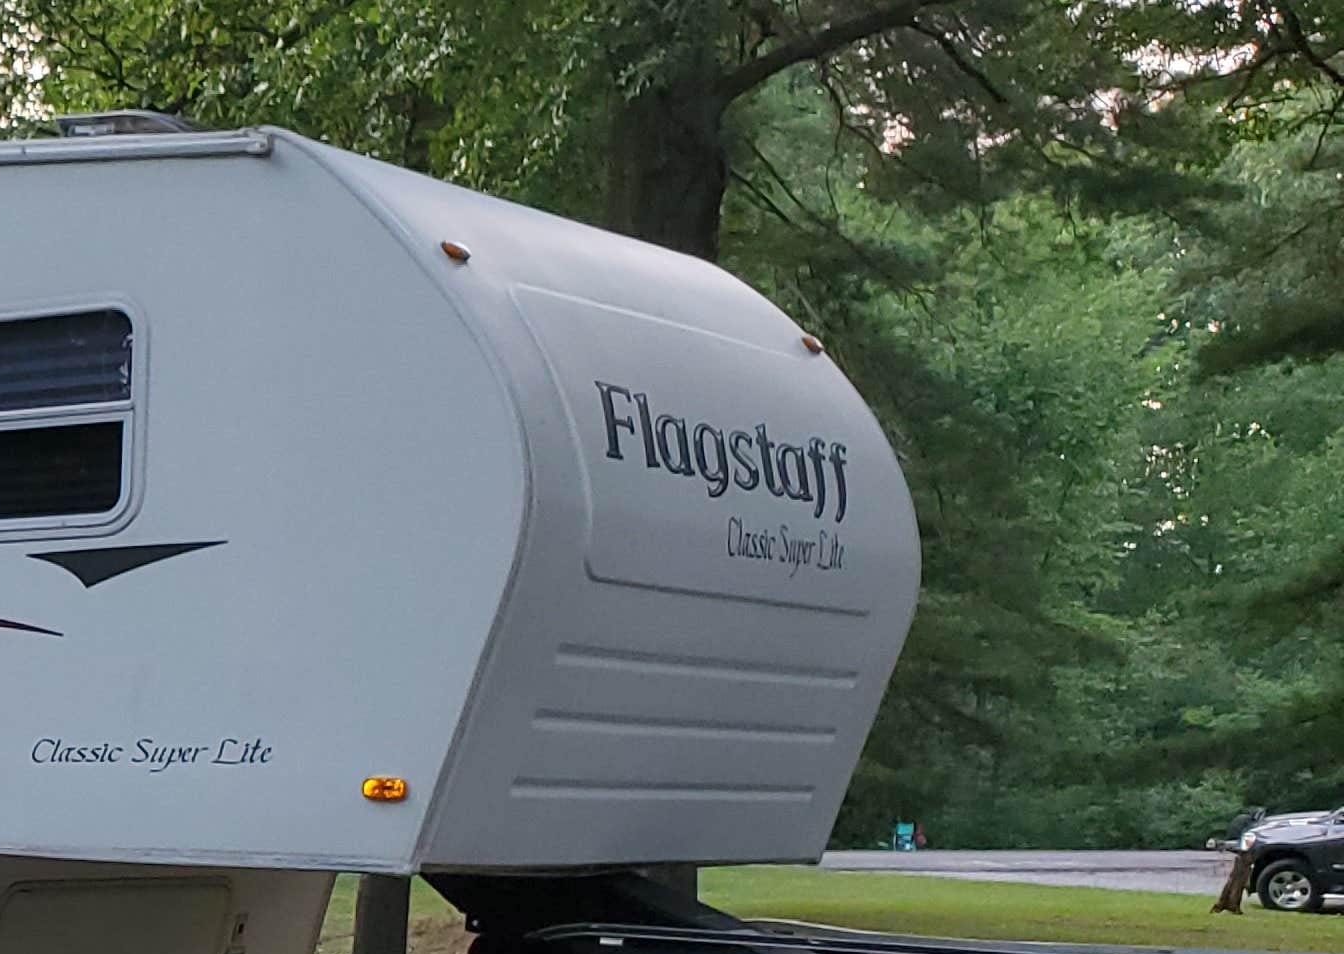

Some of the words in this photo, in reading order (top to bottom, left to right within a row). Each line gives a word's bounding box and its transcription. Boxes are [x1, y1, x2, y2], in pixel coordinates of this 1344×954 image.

[594, 380, 848, 523] Flagstaff
[727, 515, 777, 560] Classic
[778, 523, 816, 578] Super
[816, 528, 845, 571] Lite
[31, 738, 124, 764] Classic
[130, 738, 209, 773] Super
[211, 738, 274, 766] Lite
